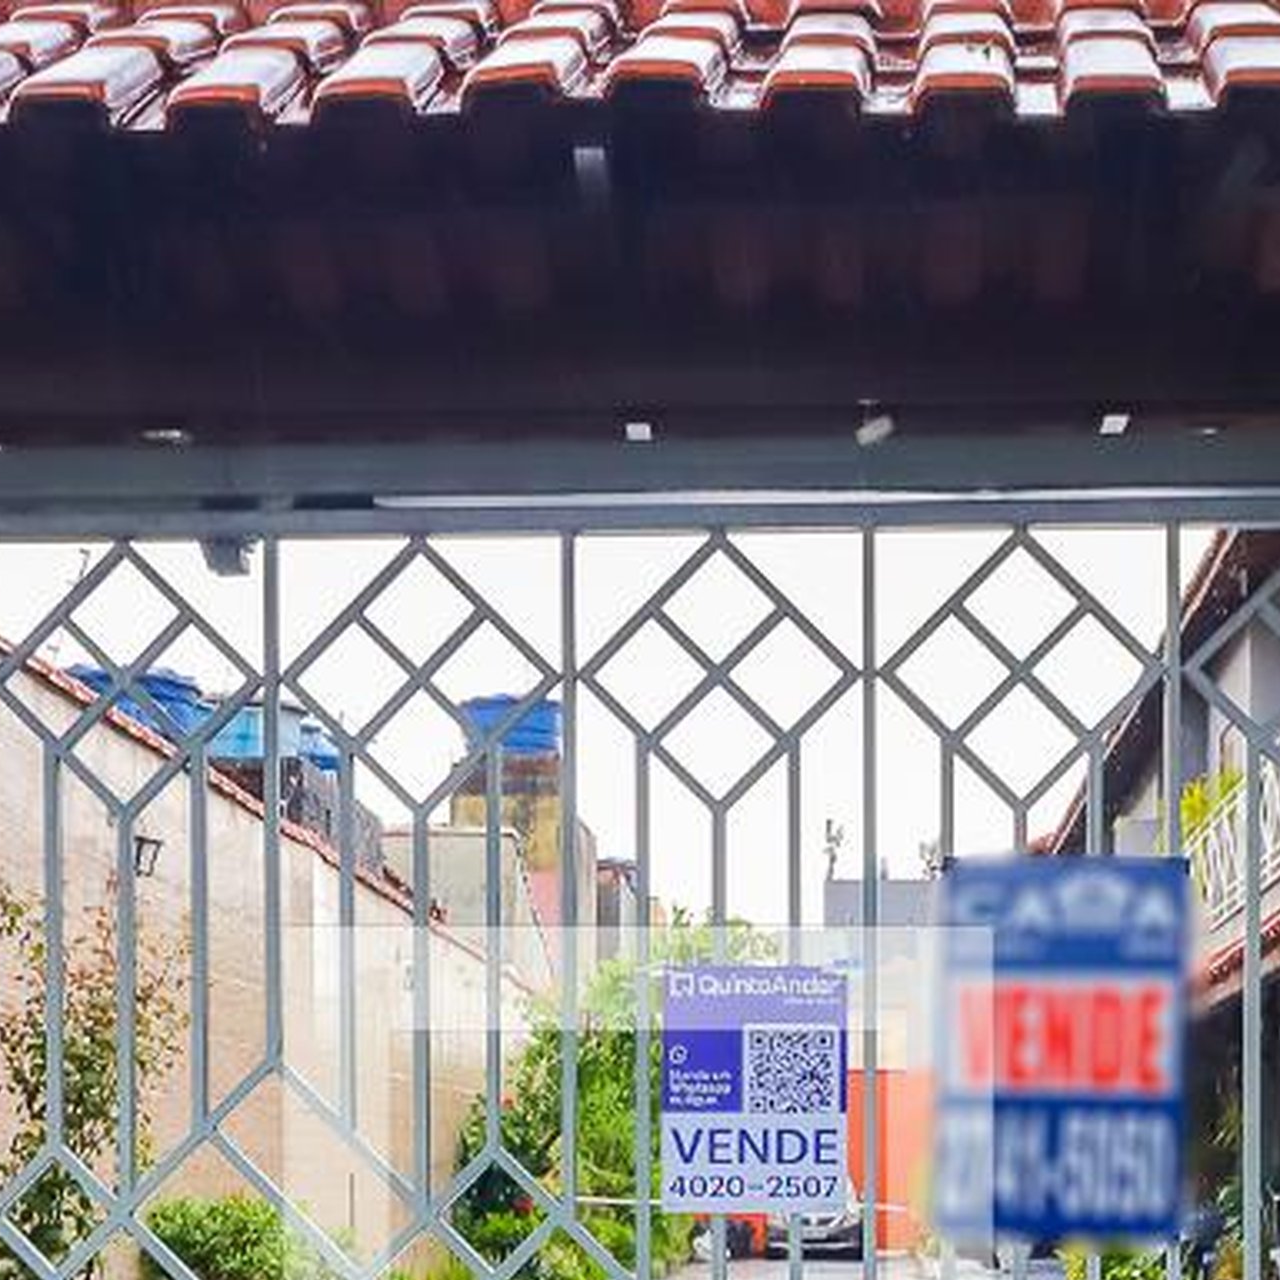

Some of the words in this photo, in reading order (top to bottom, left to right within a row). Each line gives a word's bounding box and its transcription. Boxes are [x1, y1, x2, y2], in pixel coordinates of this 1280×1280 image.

[958, 982, 1170, 1094] VENDE
[671, 1128, 838, 1165] VENDE
[669, 1175, 838, 1198] 4020-2507
